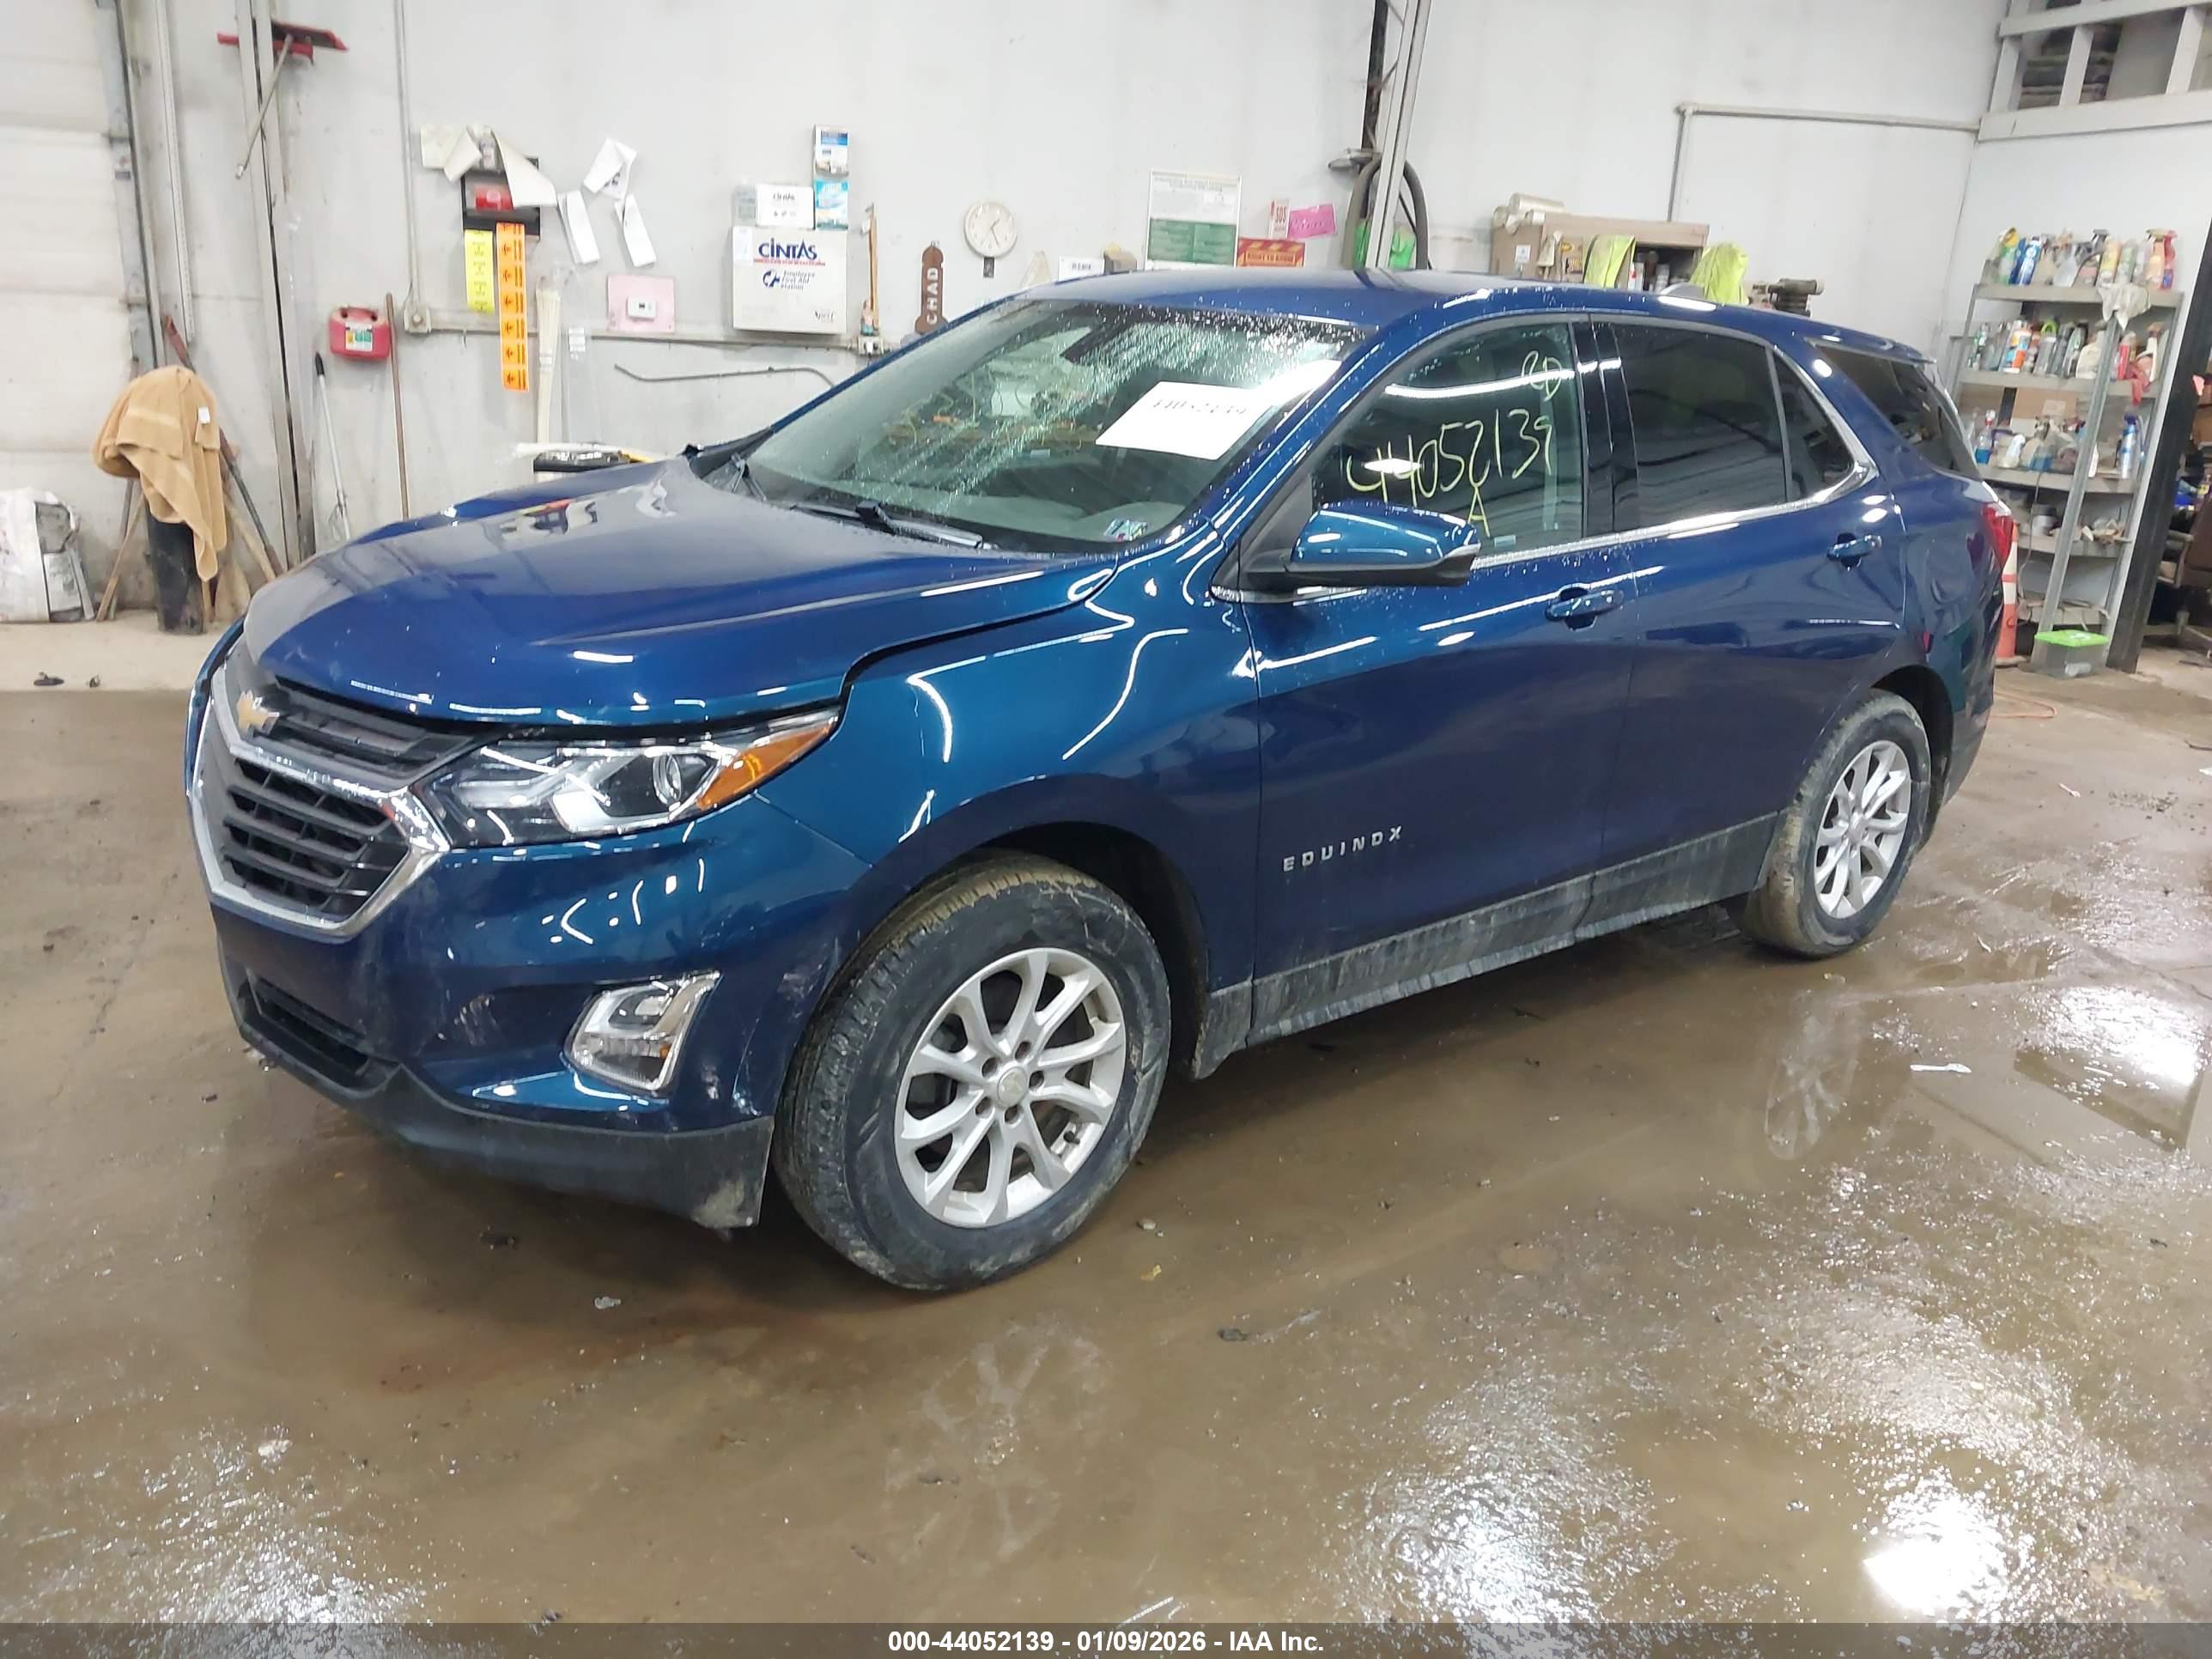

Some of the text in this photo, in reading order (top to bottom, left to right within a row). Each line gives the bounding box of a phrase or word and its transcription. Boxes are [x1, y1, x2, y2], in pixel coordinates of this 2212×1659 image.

[758, 237, 818, 261] CINTAS
[927, 267, 939, 325] CHAD
[1346, 408, 1554, 508] 44052139
[1283, 825, 1402, 872] EQUINOX
